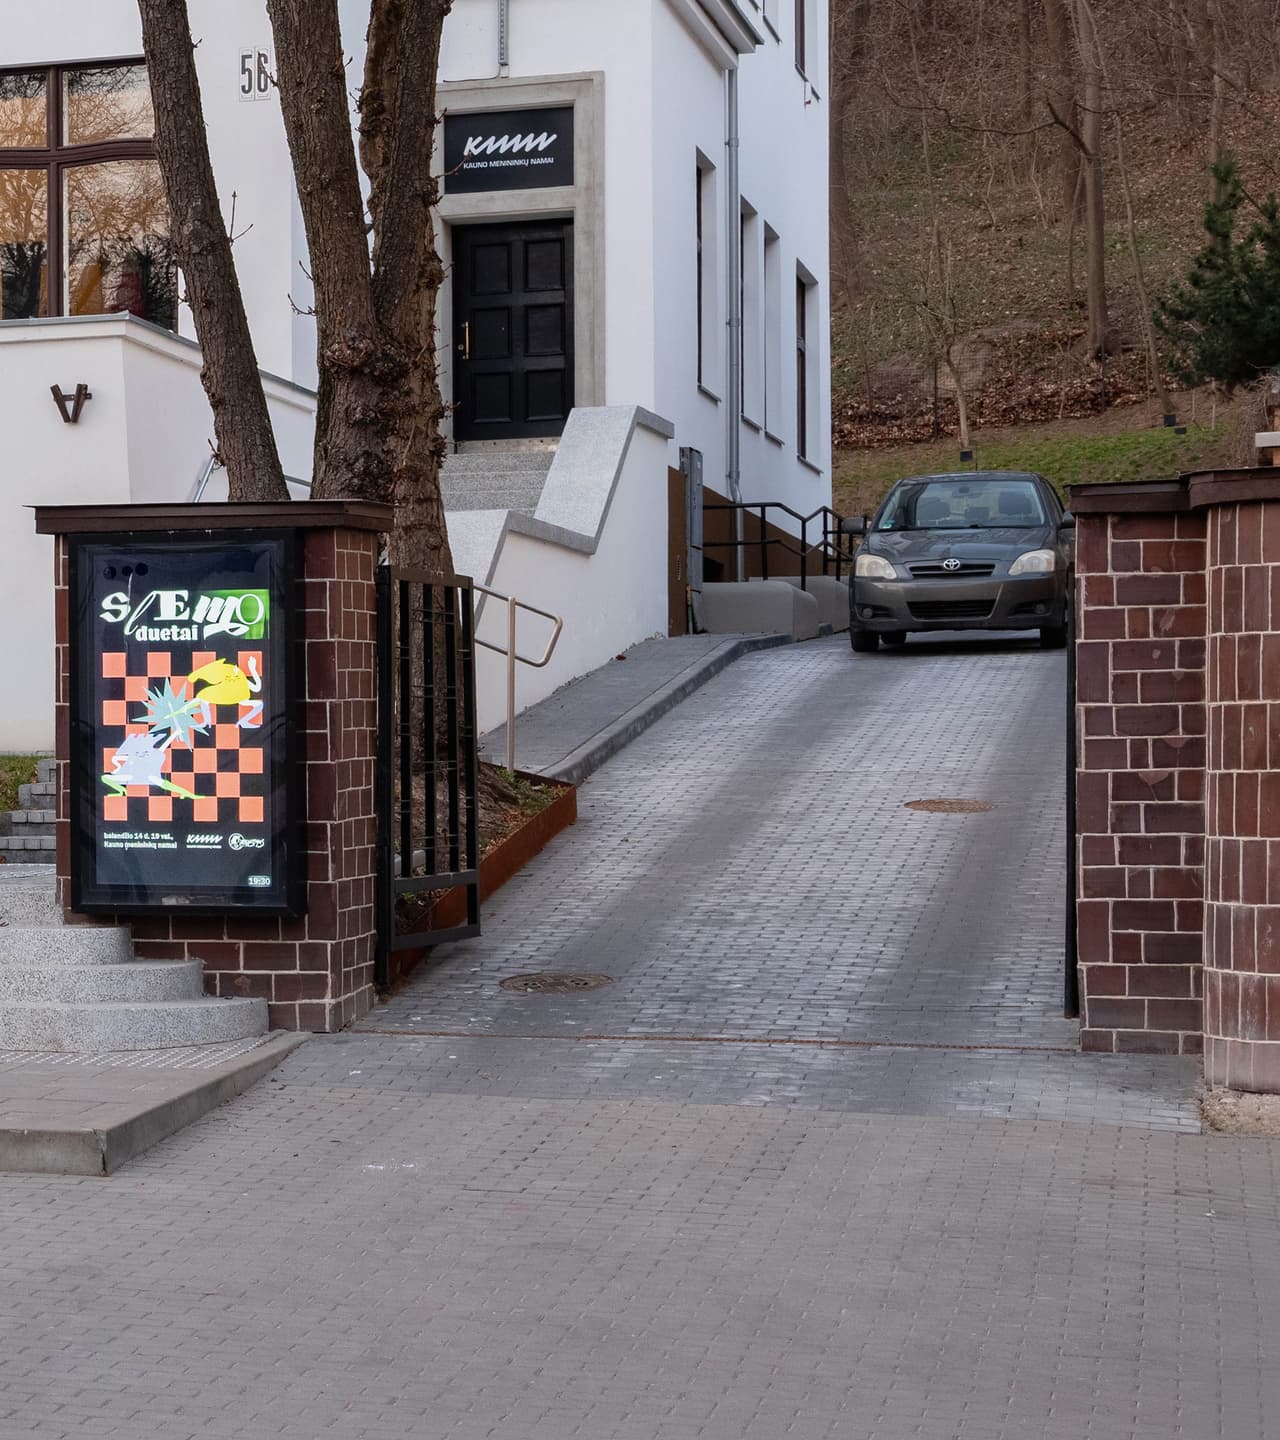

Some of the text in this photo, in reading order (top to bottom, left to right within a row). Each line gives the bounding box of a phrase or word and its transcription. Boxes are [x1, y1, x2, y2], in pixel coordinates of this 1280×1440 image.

[241, 53, 269, 94] 56
[463, 157, 554, 169] KAUNO MENININKŲ NAMAI
[135, 625, 198, 641] duetai
